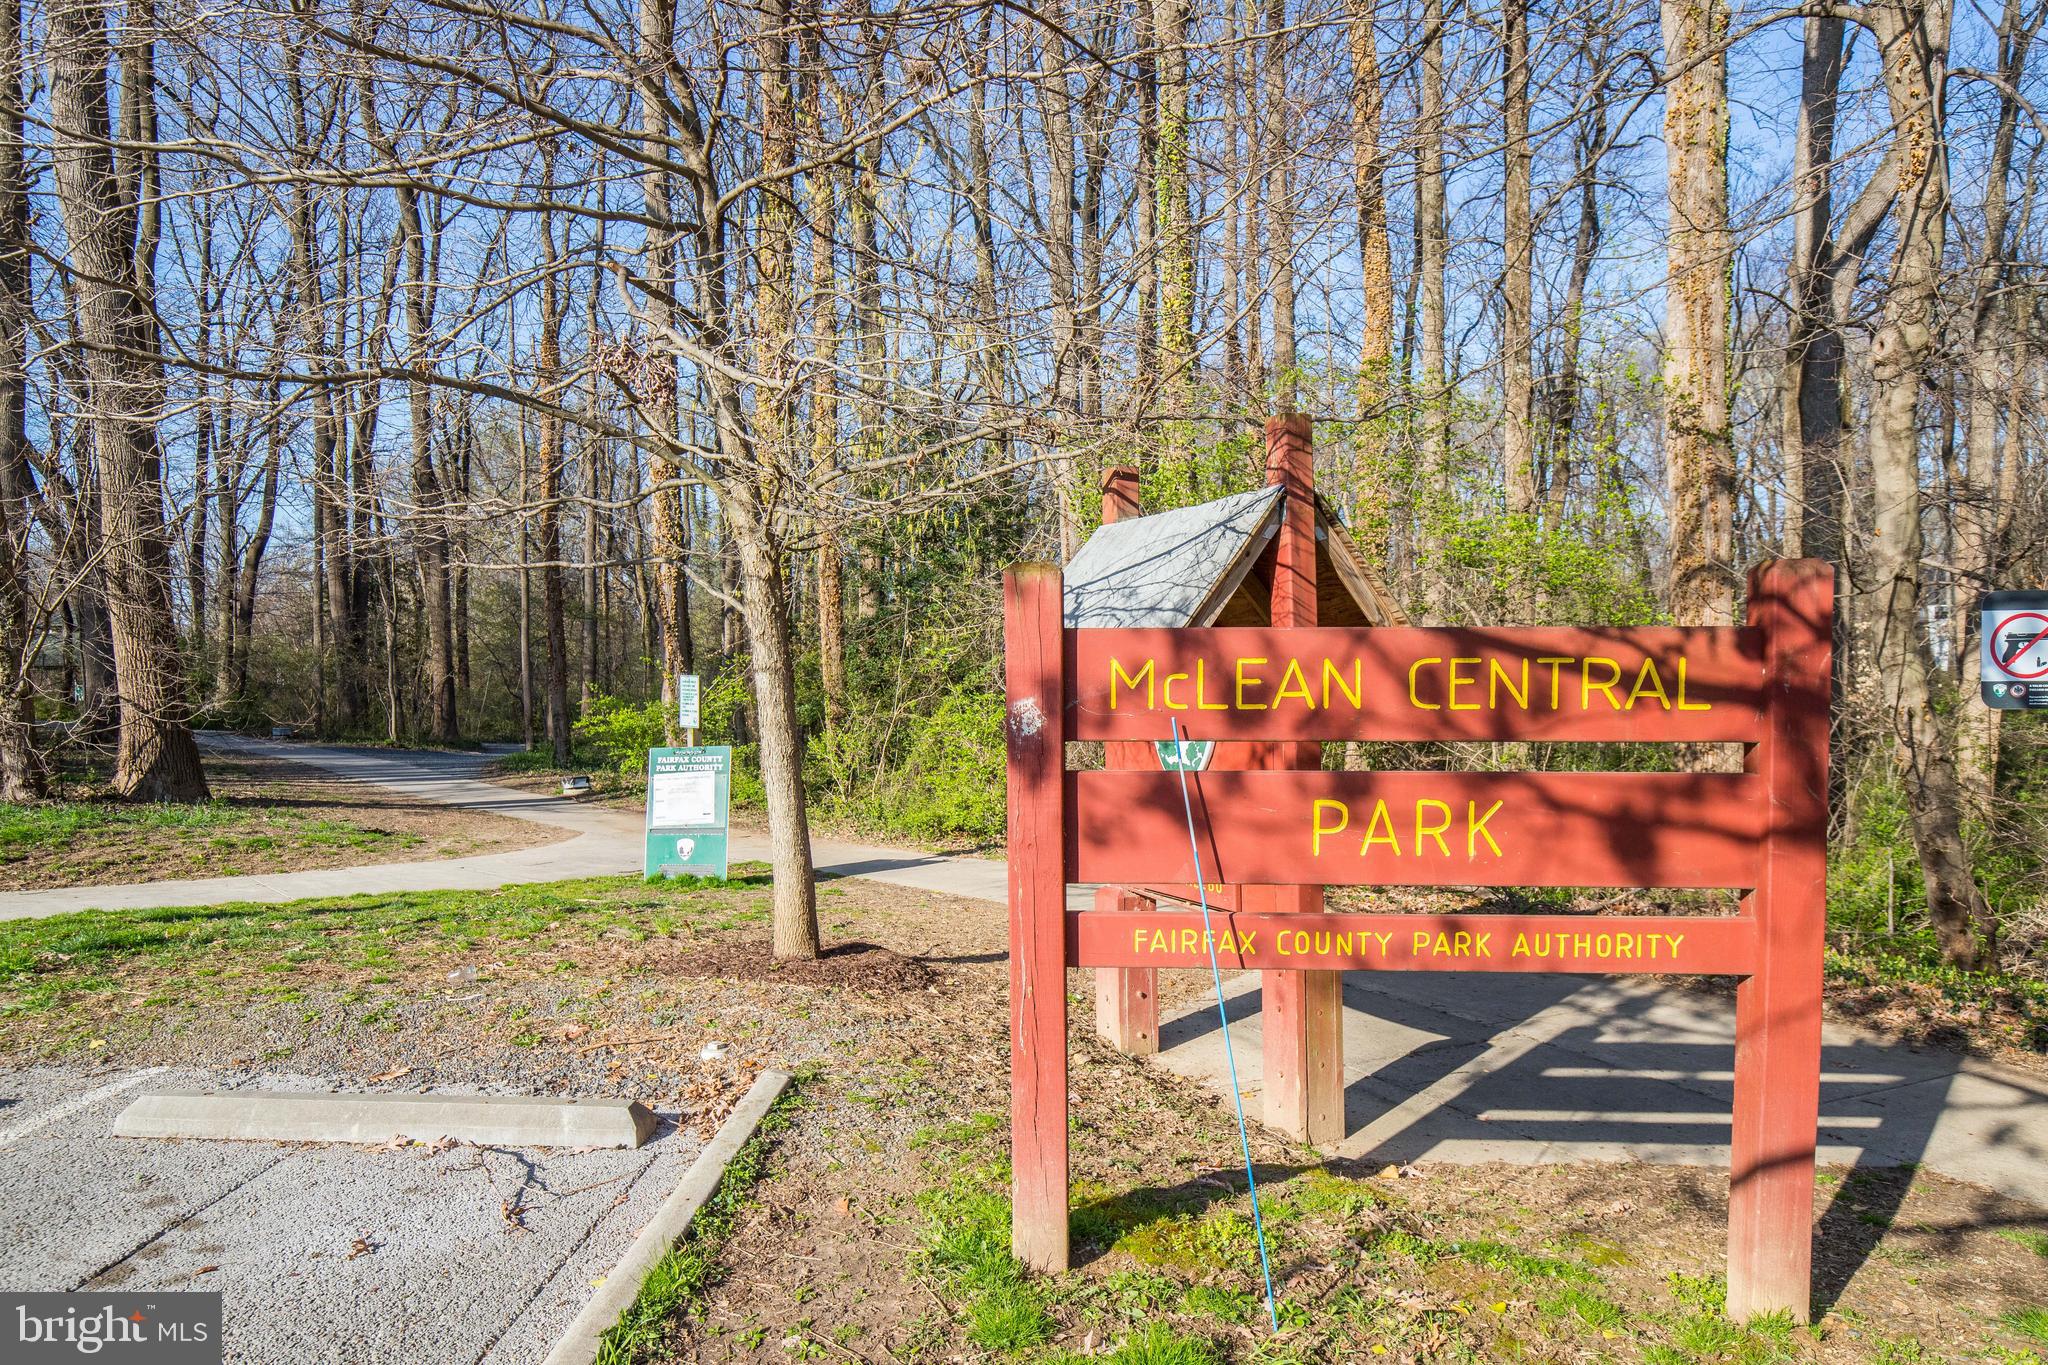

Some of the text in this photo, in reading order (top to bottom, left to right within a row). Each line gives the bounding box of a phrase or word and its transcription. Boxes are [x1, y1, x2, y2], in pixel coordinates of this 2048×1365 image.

[1109, 656, 1712, 711] McLEAN CENTRAL
[678, 763, 723, 771] AUTHORITY
[1311, 798, 1504, 858] PARK
[1133, 927, 1685, 960] FAIRFAX COUNTY PARK AUTHORITY
